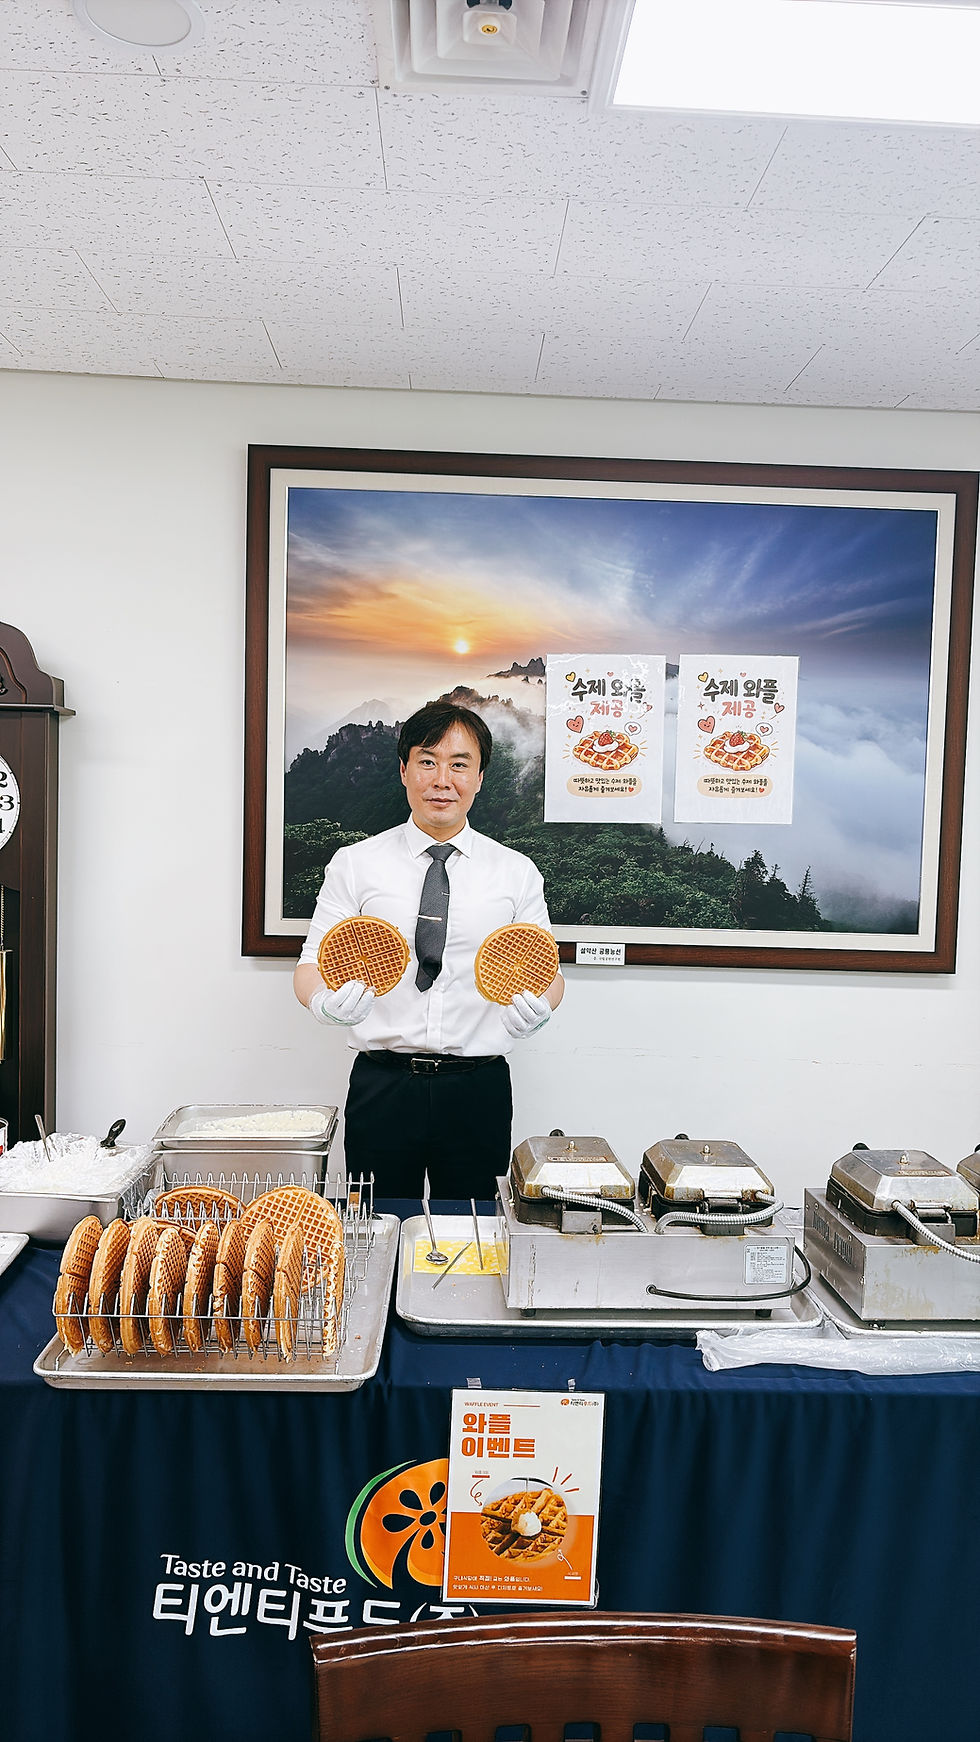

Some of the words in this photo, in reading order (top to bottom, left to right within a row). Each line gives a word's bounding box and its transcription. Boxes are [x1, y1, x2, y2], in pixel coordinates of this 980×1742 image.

[571, 678, 606, 702] 수제
[703, 678, 739, 702] 수제
[743, 678, 779, 704] 와플
[589, 699, 625, 718] 제공
[721, 699, 757, 719] 제공
[462, 1413, 511, 1434] 와플
[461, 1437, 536, 1459] 이벤트
[160, 1553, 227, 1579] Taste
[231, 1561, 280, 1581] and
[284, 1562, 346, 1594] Taste
